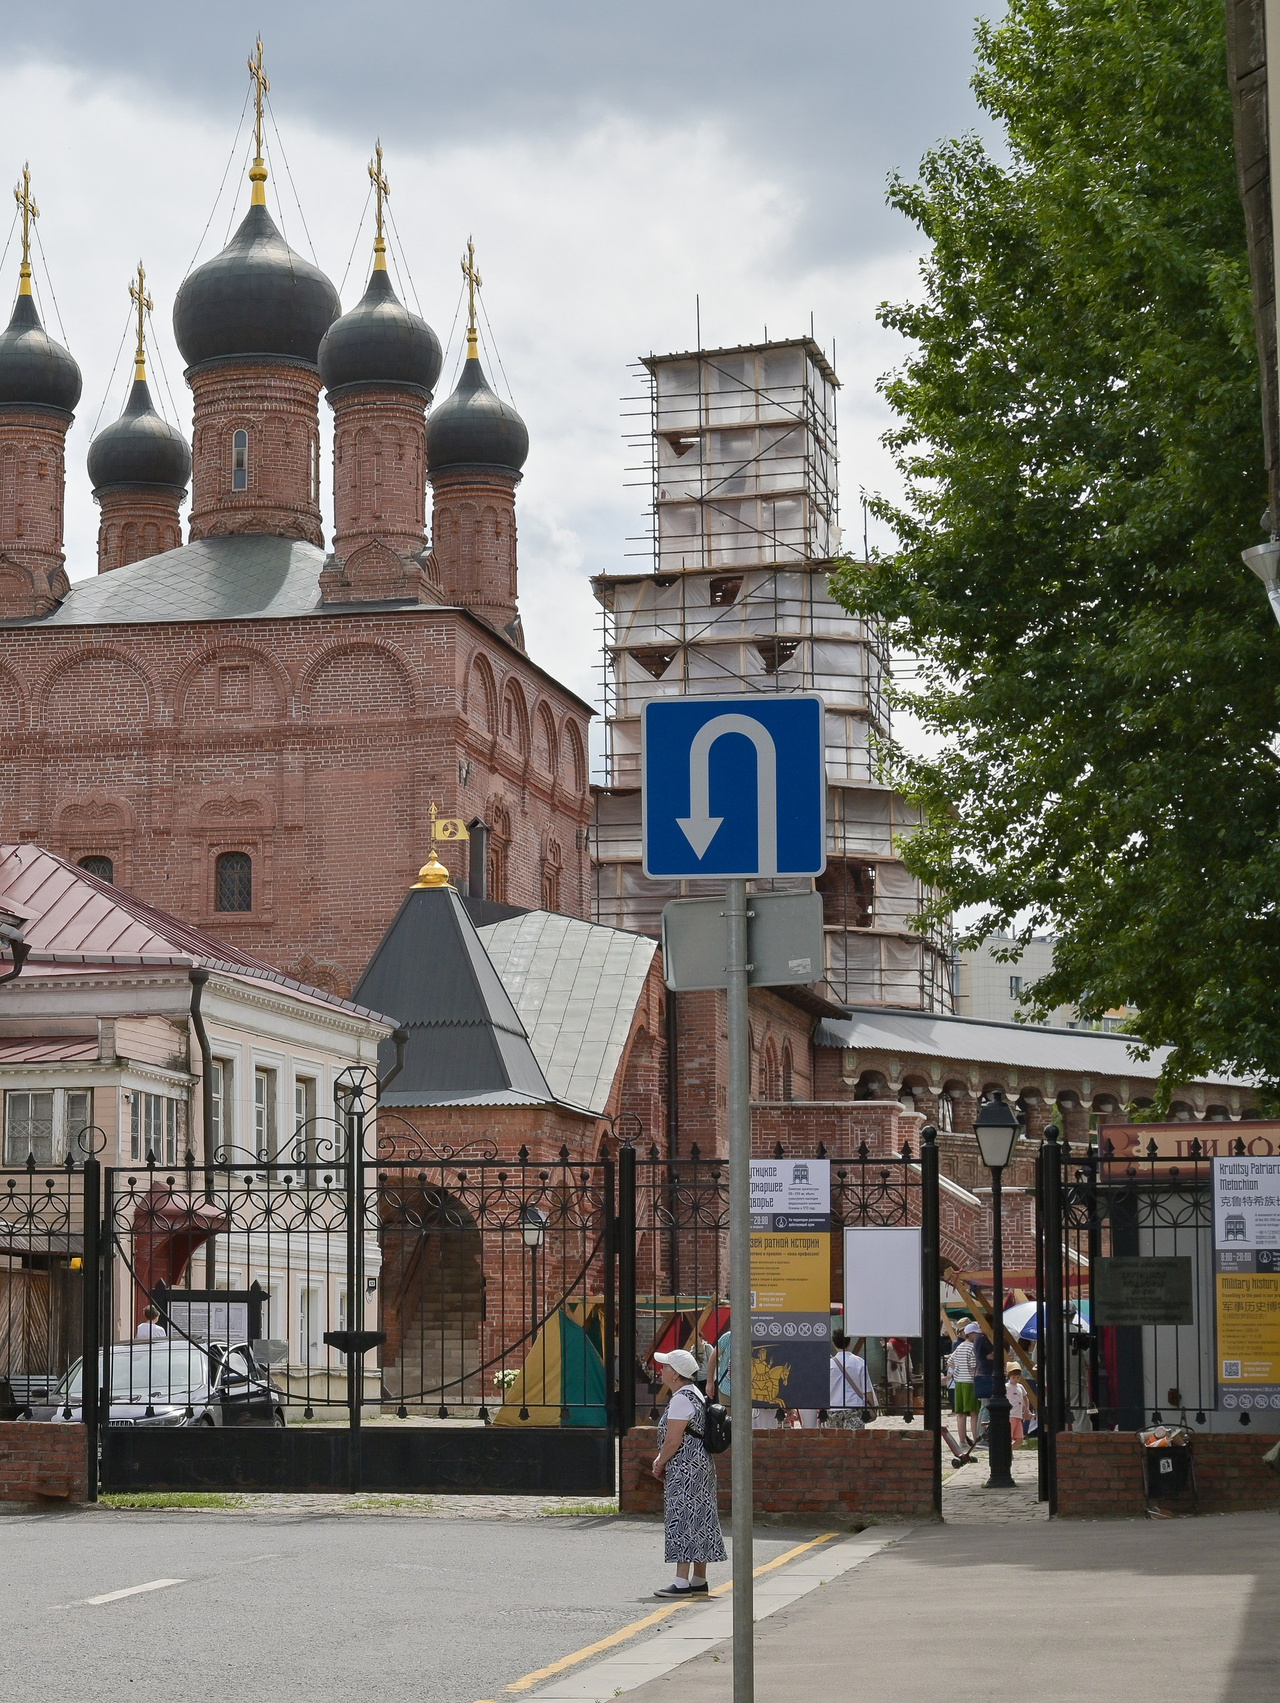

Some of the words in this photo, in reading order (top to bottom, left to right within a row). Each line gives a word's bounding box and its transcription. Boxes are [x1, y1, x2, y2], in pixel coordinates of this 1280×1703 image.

[1219, 1163, 1248, 1177] Krutitsy
[750, 1183, 783, 1194] риаршее
[1220, 1179, 1258, 1190] Metochion
[764, 1237, 788, 1250] ратной
[791, 1239, 820, 1250] истории
[1222, 1278, 1250, 1292] Military
[1252, 1278, 1278, 1292] history
